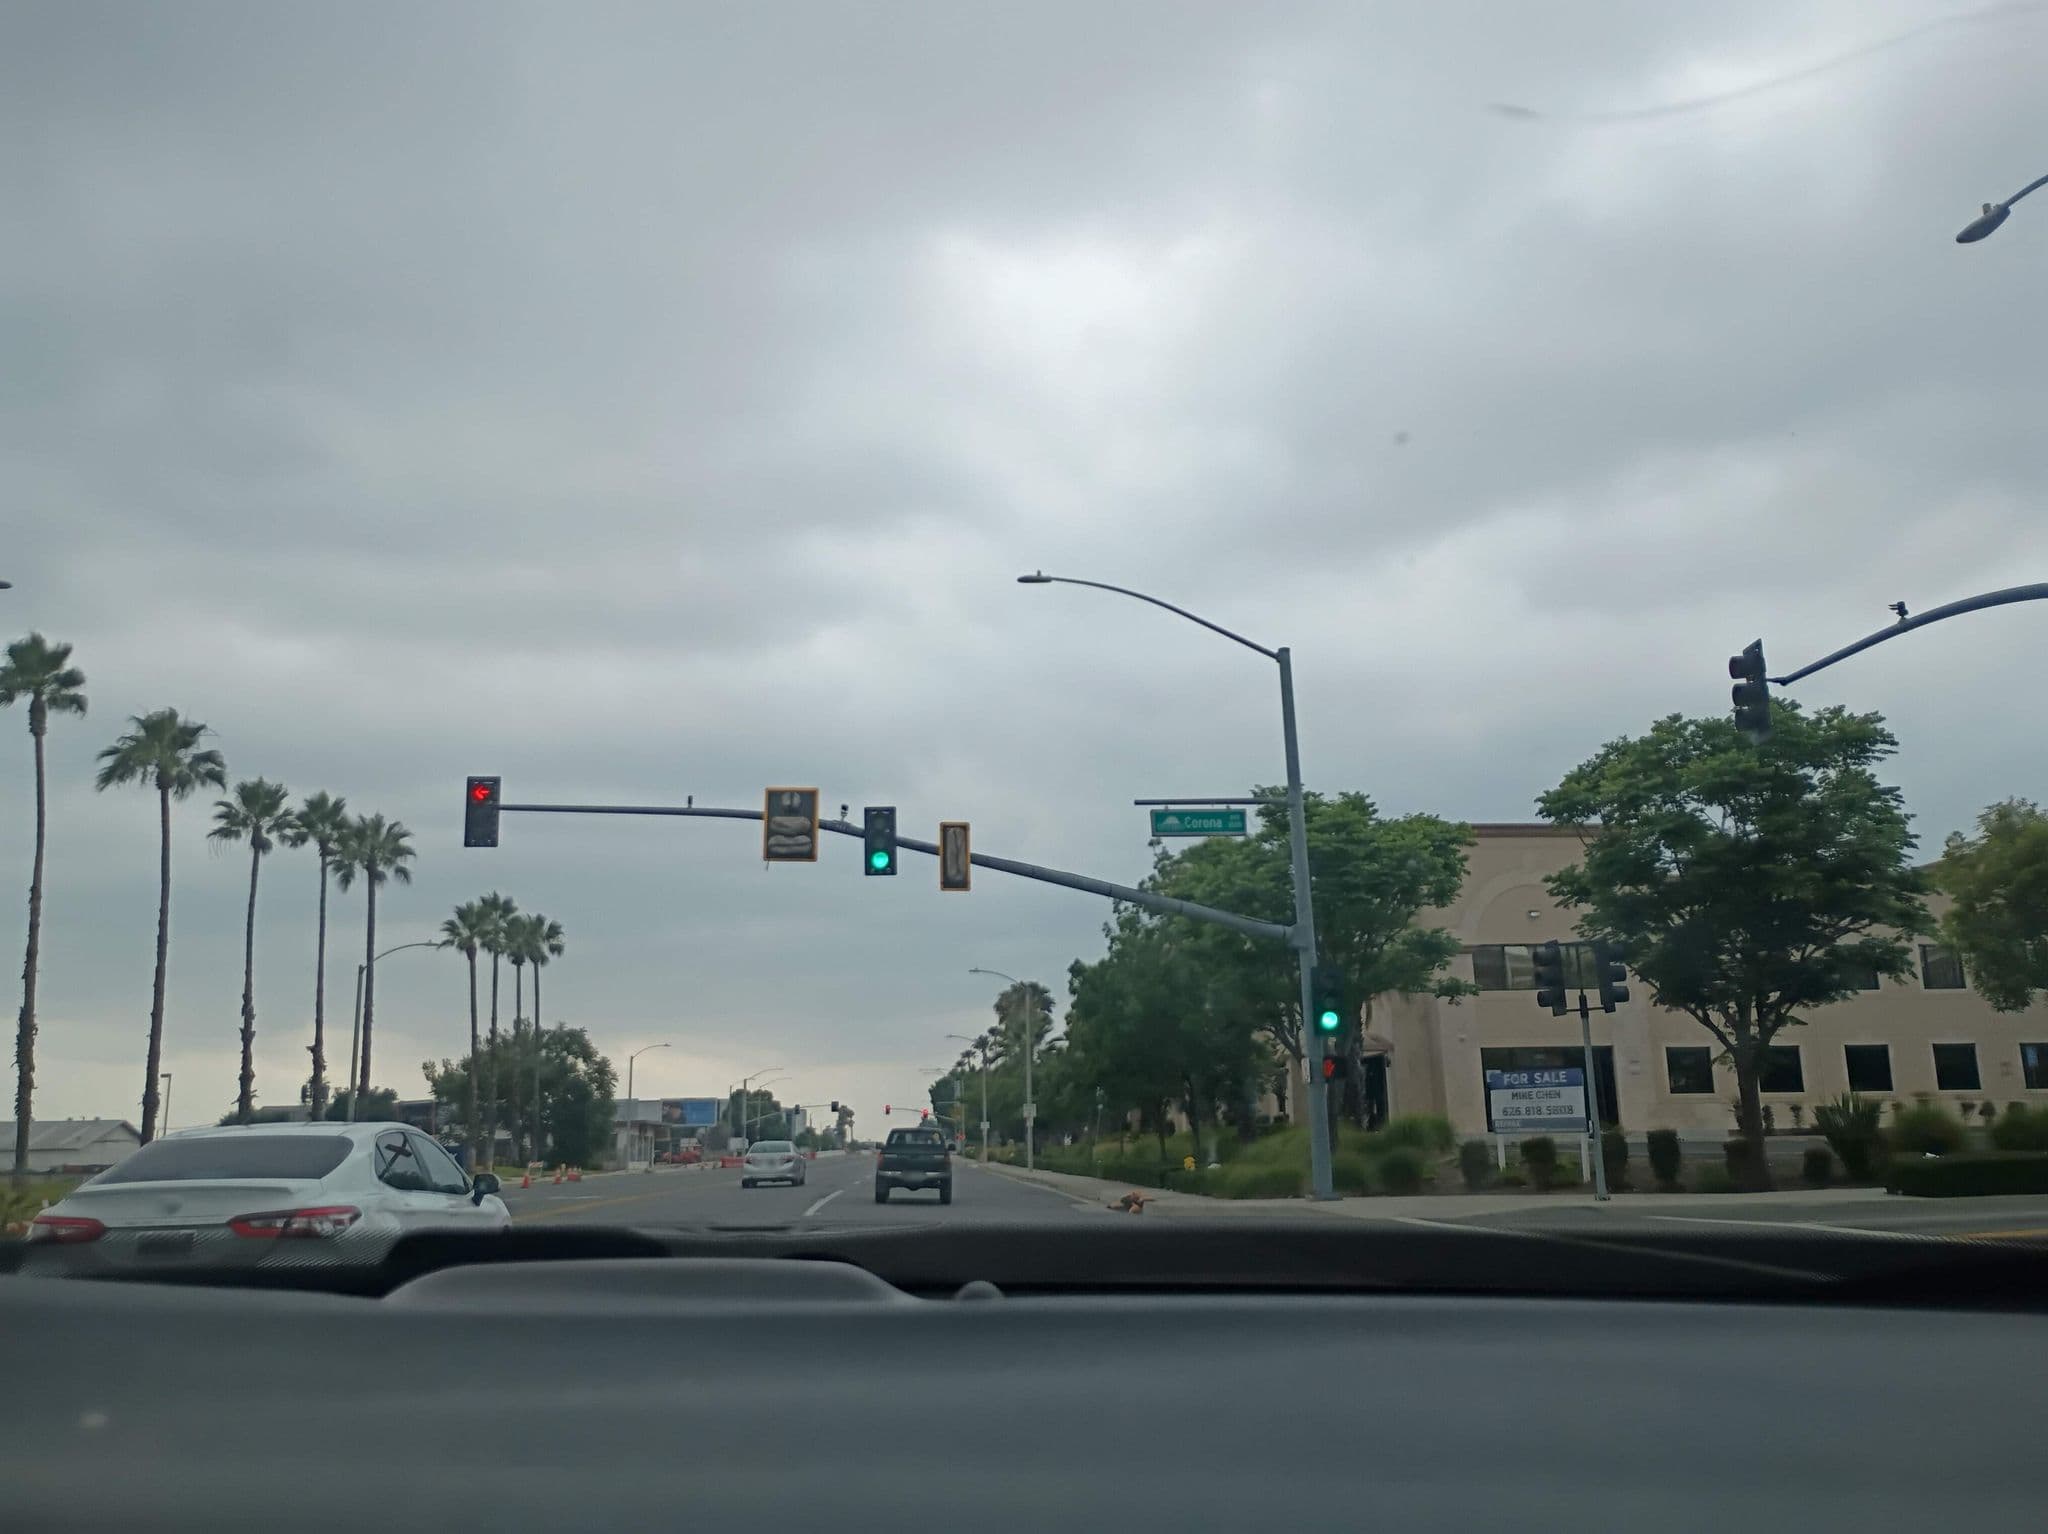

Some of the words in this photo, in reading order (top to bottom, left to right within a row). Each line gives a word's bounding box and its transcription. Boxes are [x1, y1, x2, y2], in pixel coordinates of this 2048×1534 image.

[1184, 816, 1223, 828] Corona
[1503, 1073, 1529, 1085] FOR
[1534, 1071, 1567, 1083] SALE
[1511, 1090, 1534, 1100] MIKE
[1535, 1089, 1561, 1099] CHEN
